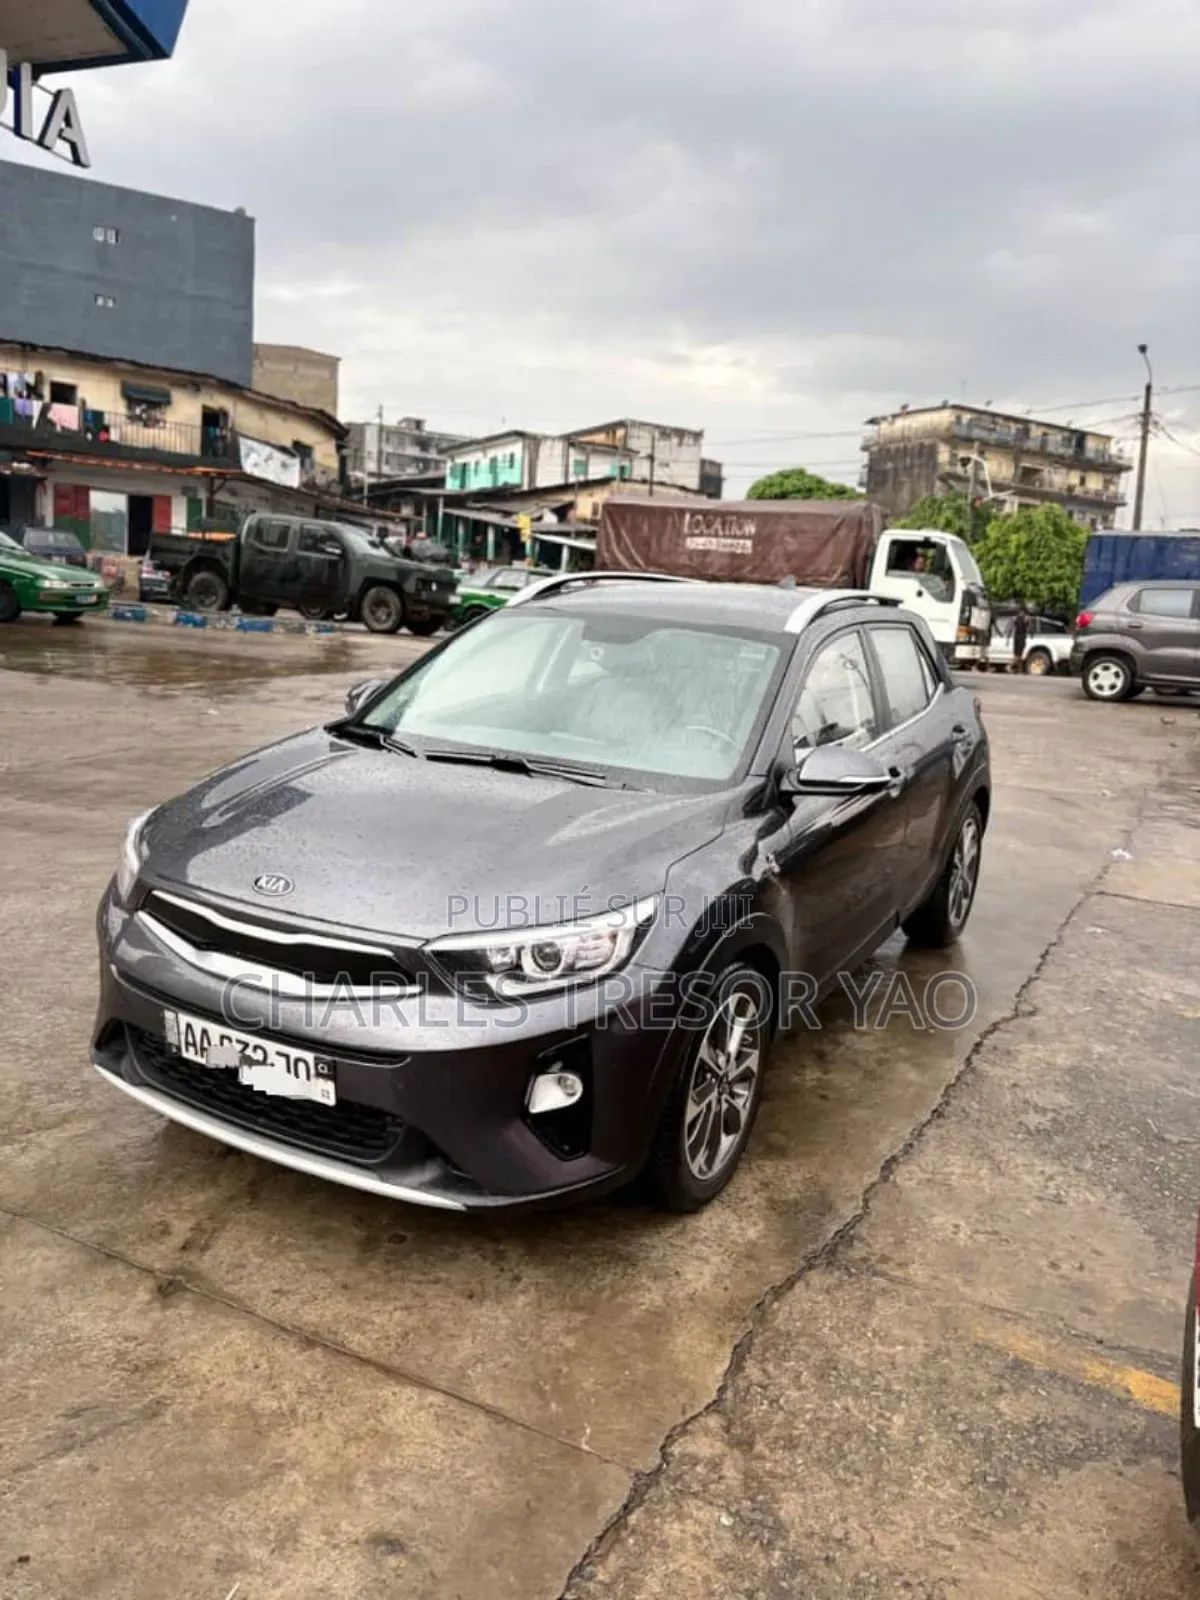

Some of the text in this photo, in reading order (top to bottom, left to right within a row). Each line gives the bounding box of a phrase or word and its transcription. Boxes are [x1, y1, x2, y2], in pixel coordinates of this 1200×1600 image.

[0, 48, 91, 168] IA
[684, 512, 756, 536] LOCATION
[257, 874, 285, 893] KIA
